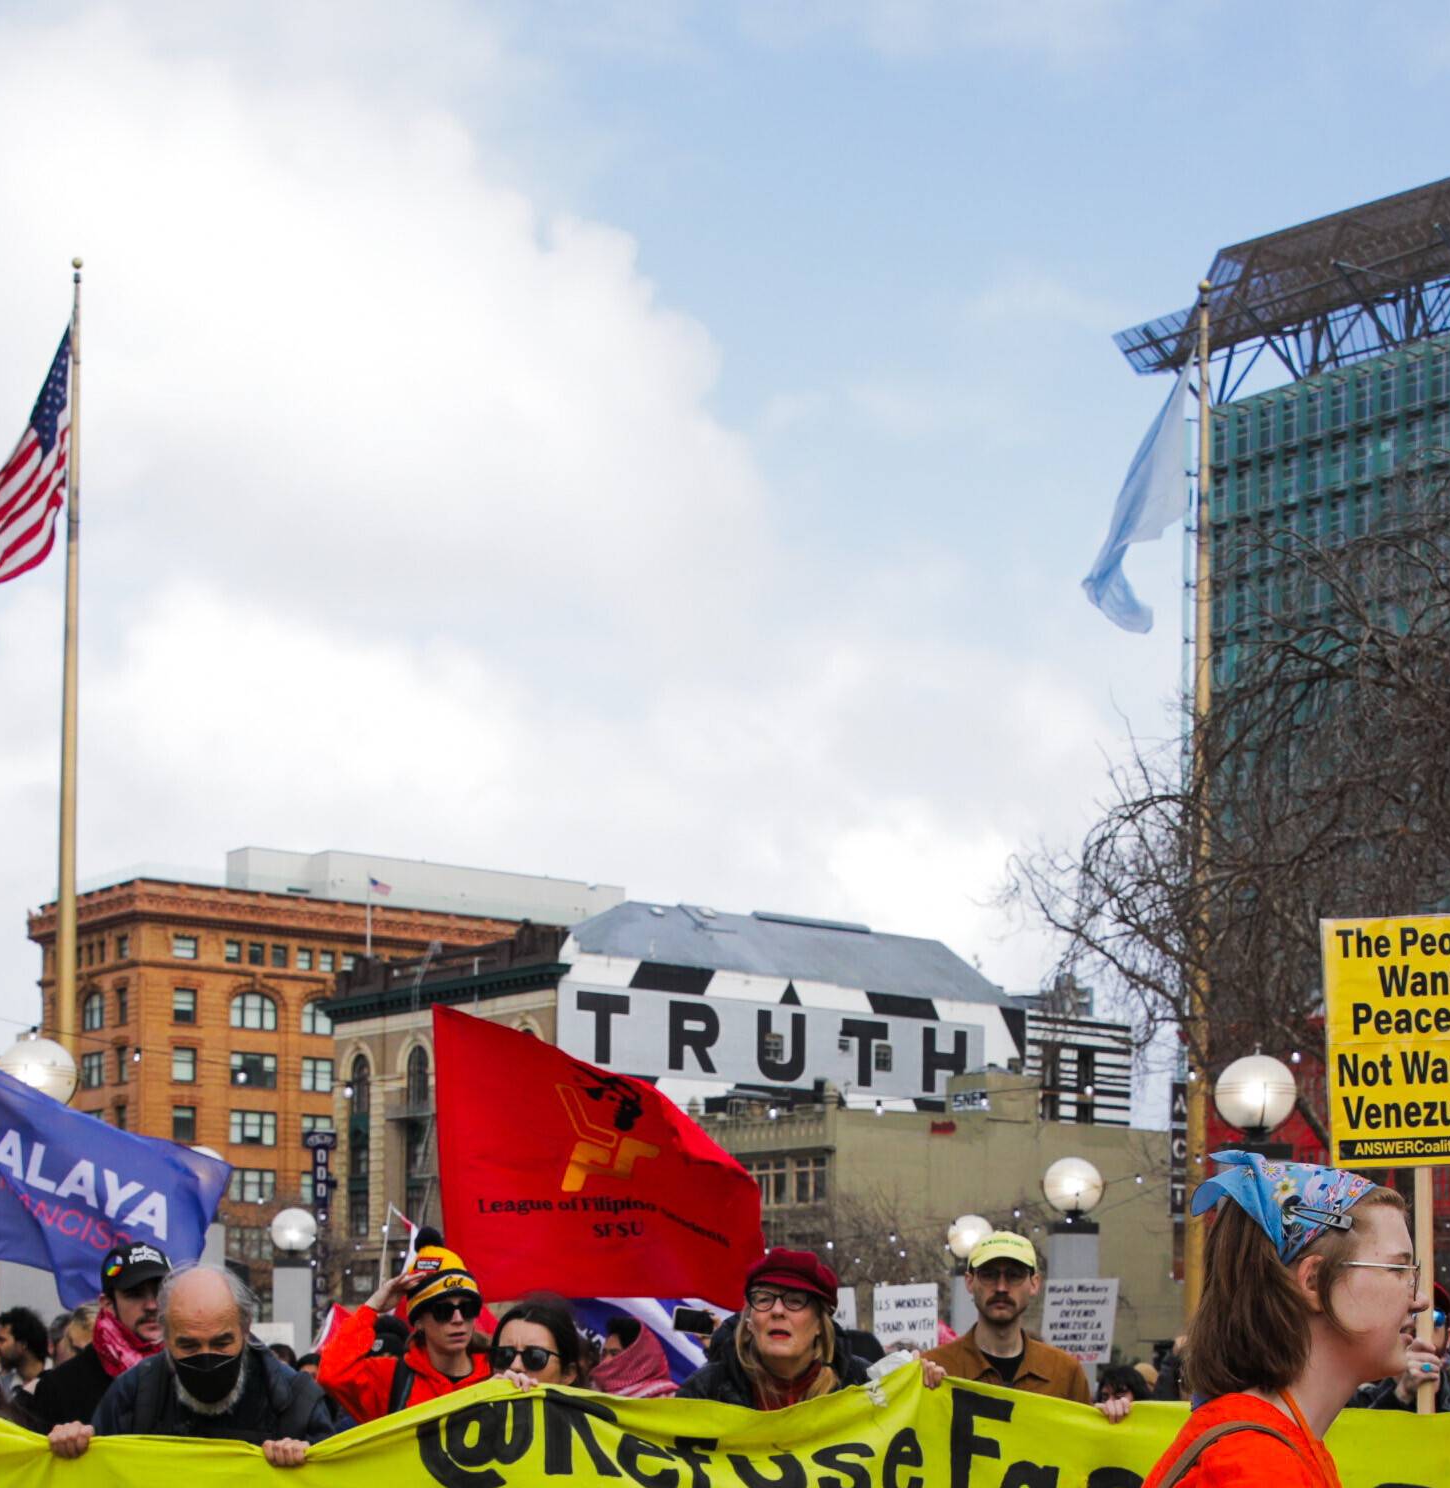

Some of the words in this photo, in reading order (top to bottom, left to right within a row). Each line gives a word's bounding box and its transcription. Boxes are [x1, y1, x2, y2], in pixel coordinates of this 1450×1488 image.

[1336, 928, 1391, 958] The
[577, 990, 967, 1093] TRUTH
[1338, 1053, 1393, 1087] Not
[478, 1199, 553, 1215] League
[558, 1197, 577, 1211] of
[592, 1220, 644, 1238] SFSU
[443, 1276, 465, 1288] Cal
